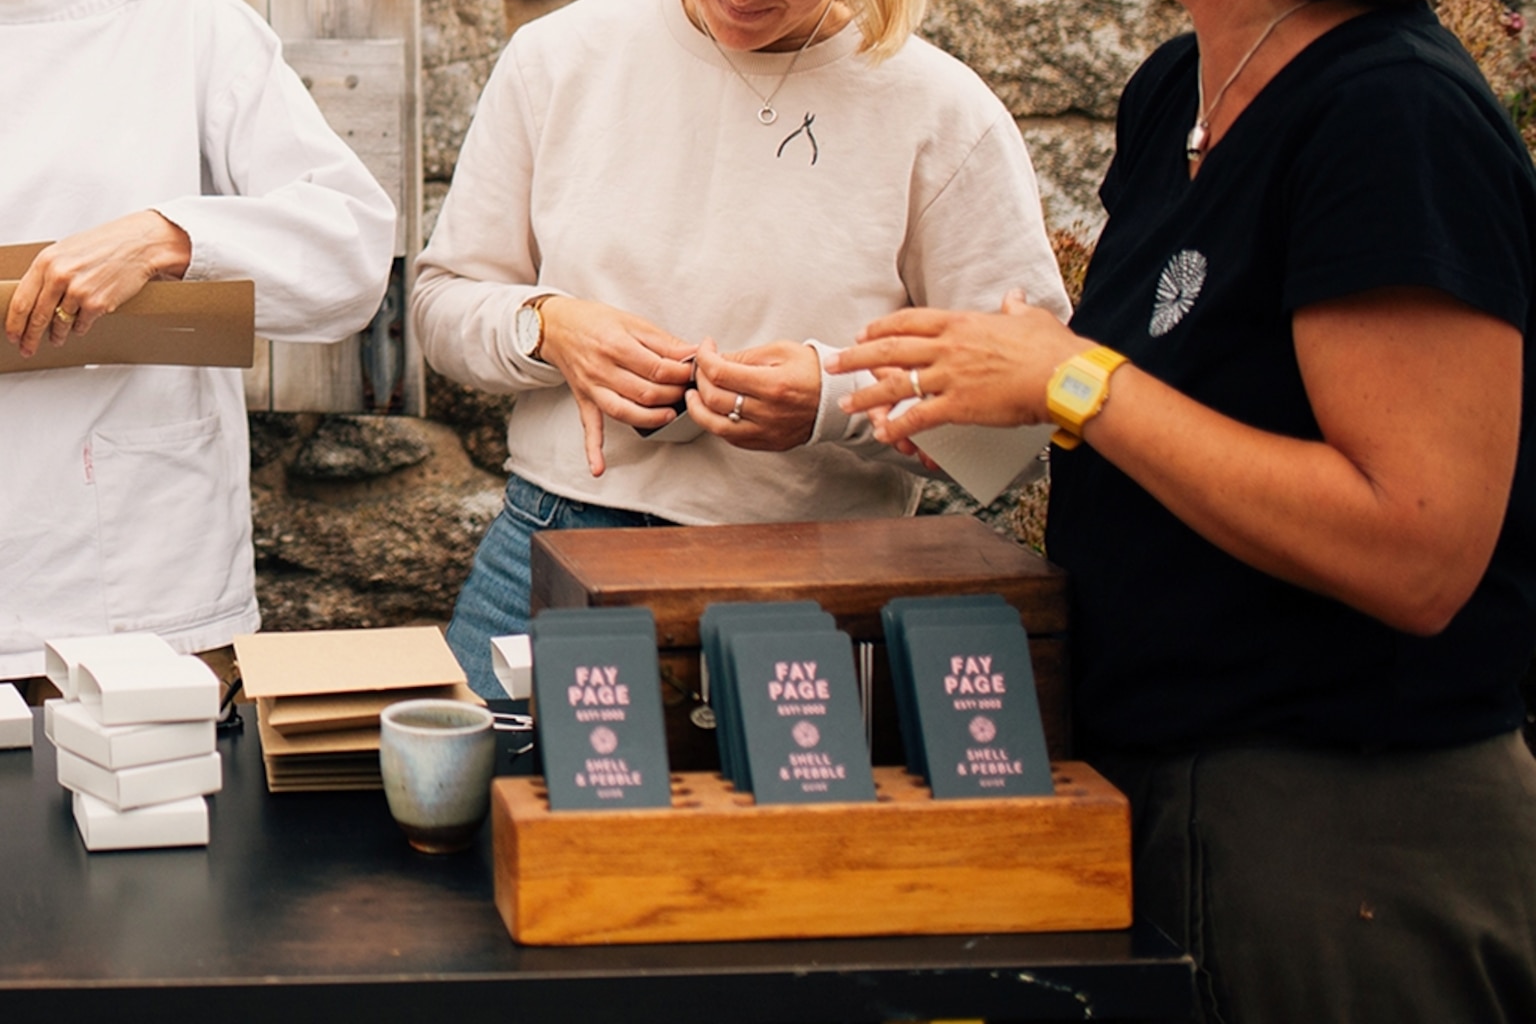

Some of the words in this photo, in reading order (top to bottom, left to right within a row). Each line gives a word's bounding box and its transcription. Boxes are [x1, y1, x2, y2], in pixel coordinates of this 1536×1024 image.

[775, 661, 817, 682] FAY
[950, 655, 992, 675] FAY
[575, 666, 618, 687] FAY
[944, 674, 1006, 695] PAGE
[568, 684, 630, 707] PAGE
[768, 679, 830, 701] PAGE
